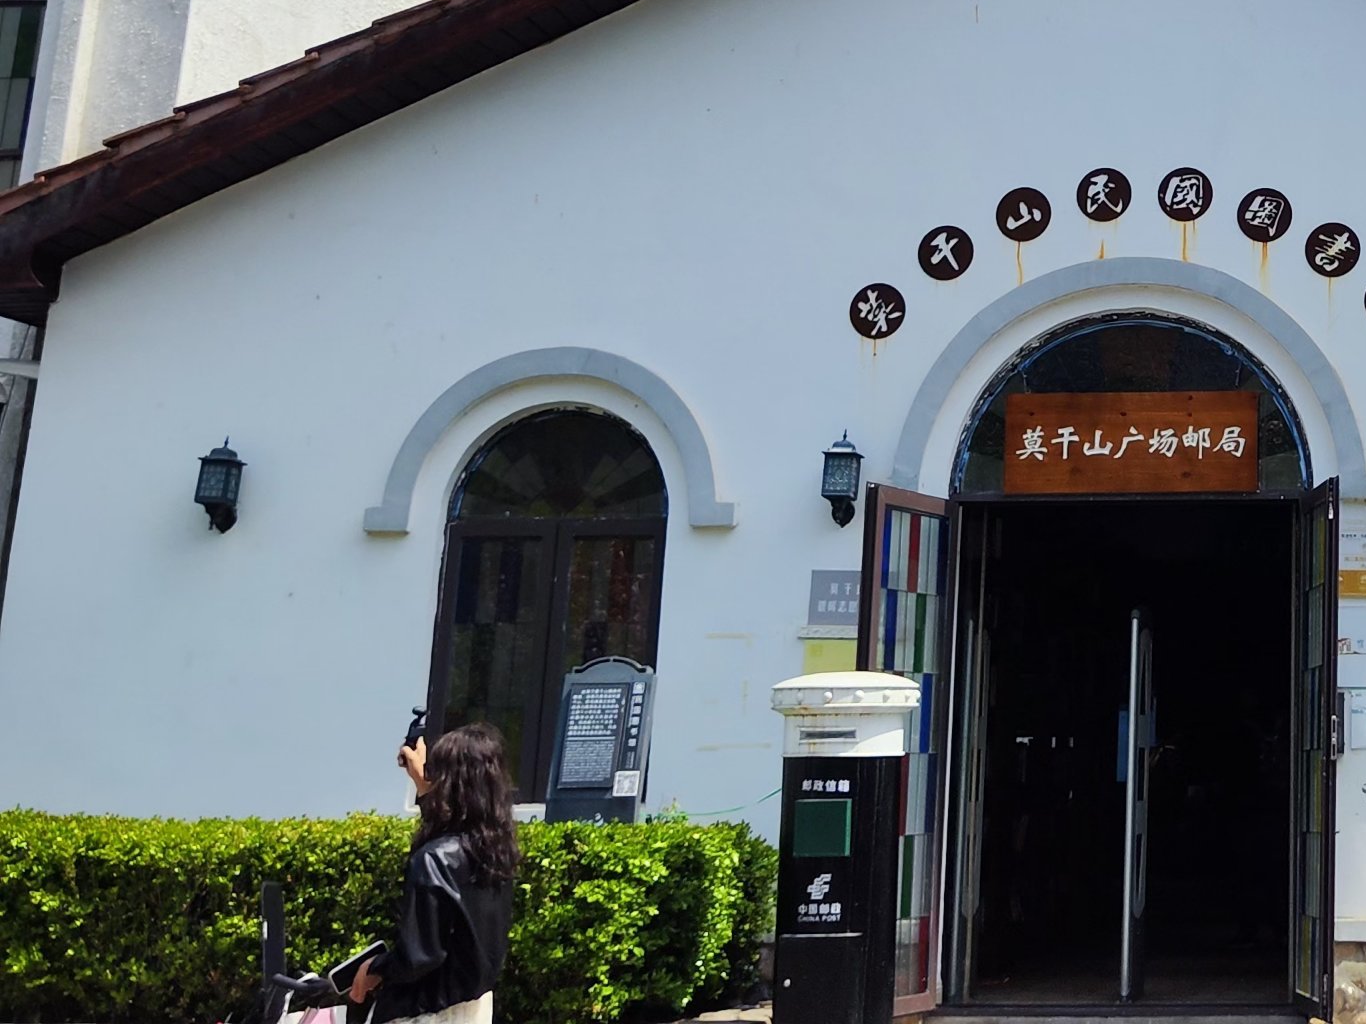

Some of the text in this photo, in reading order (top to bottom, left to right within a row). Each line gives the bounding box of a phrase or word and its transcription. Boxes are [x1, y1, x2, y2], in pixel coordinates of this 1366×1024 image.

[1015, 426, 1246, 461] 莫干山广场邮局
[801, 778, 851, 793] 邮政信箱
[797, 902, 842, 915] 中国邮政
[822, 914, 842, 923] POST
